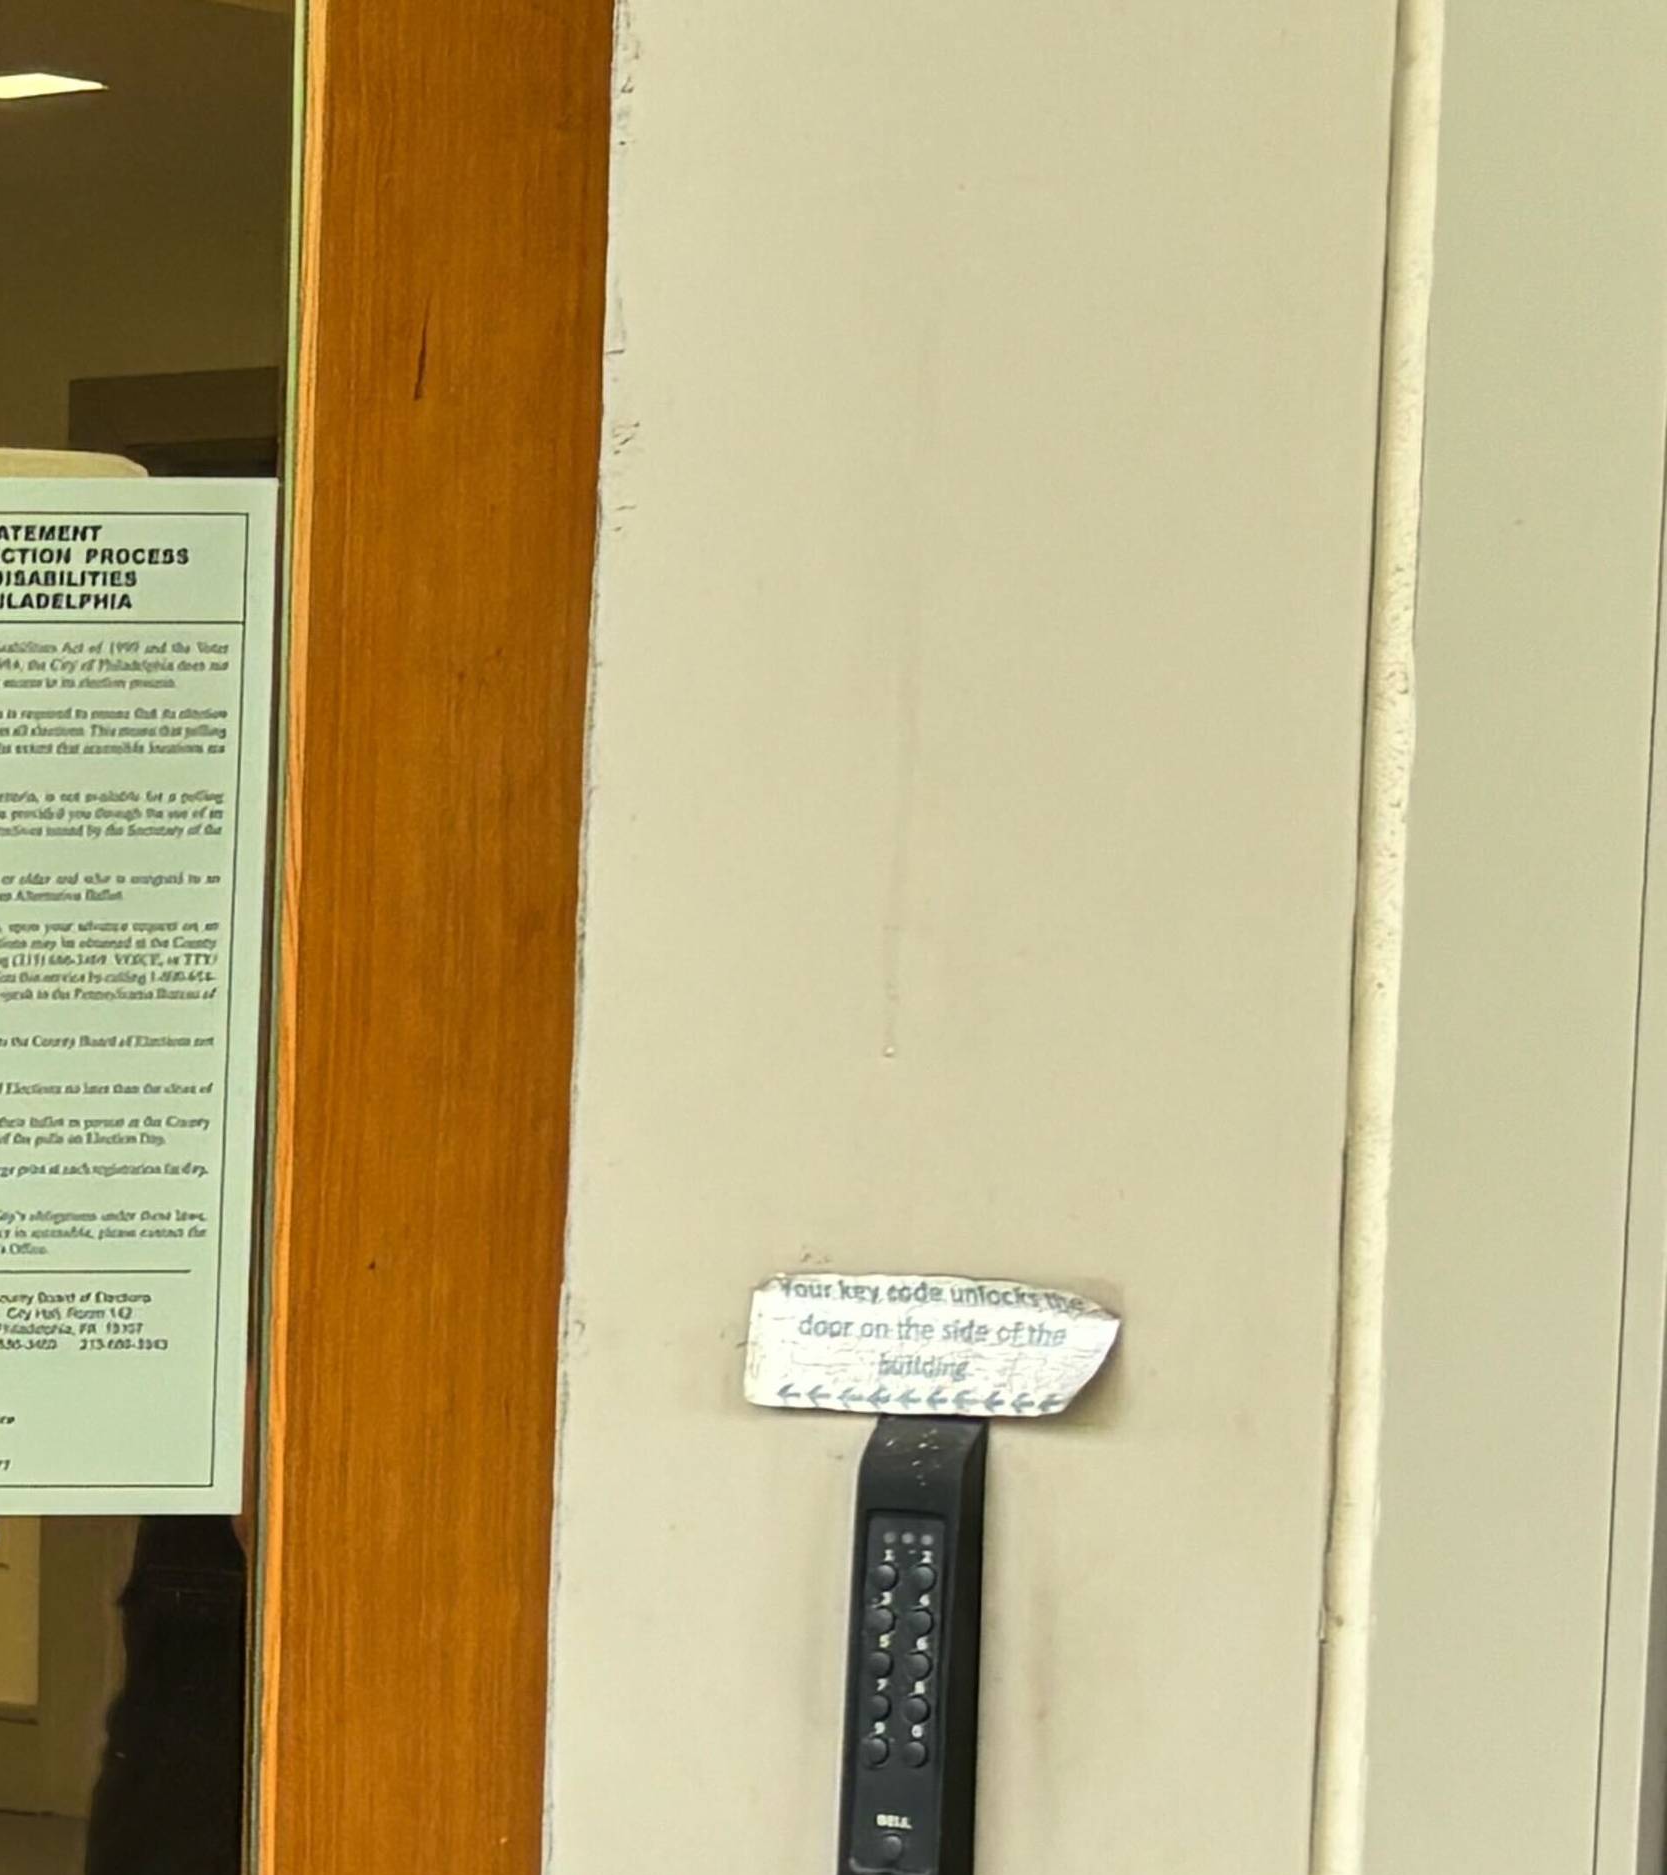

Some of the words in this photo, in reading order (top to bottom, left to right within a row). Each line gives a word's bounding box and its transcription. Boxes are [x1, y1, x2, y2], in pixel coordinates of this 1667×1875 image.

[85, 548, 190, 565] PROCESS
[840, 1280, 879, 1305] key
[887, 1282, 943, 1303] code
[950, 1286, 1039, 1309] unlocks
[6, 1307, 31, 1320] City
[799, 1314, 852, 1339] door
[862, 1322, 888, 1339] on
[897, 1316, 935, 1340] the
[942, 1319, 989, 1342] side
[997, 1322, 1024, 1346] of
[1028, 1323, 1066, 1347] the
